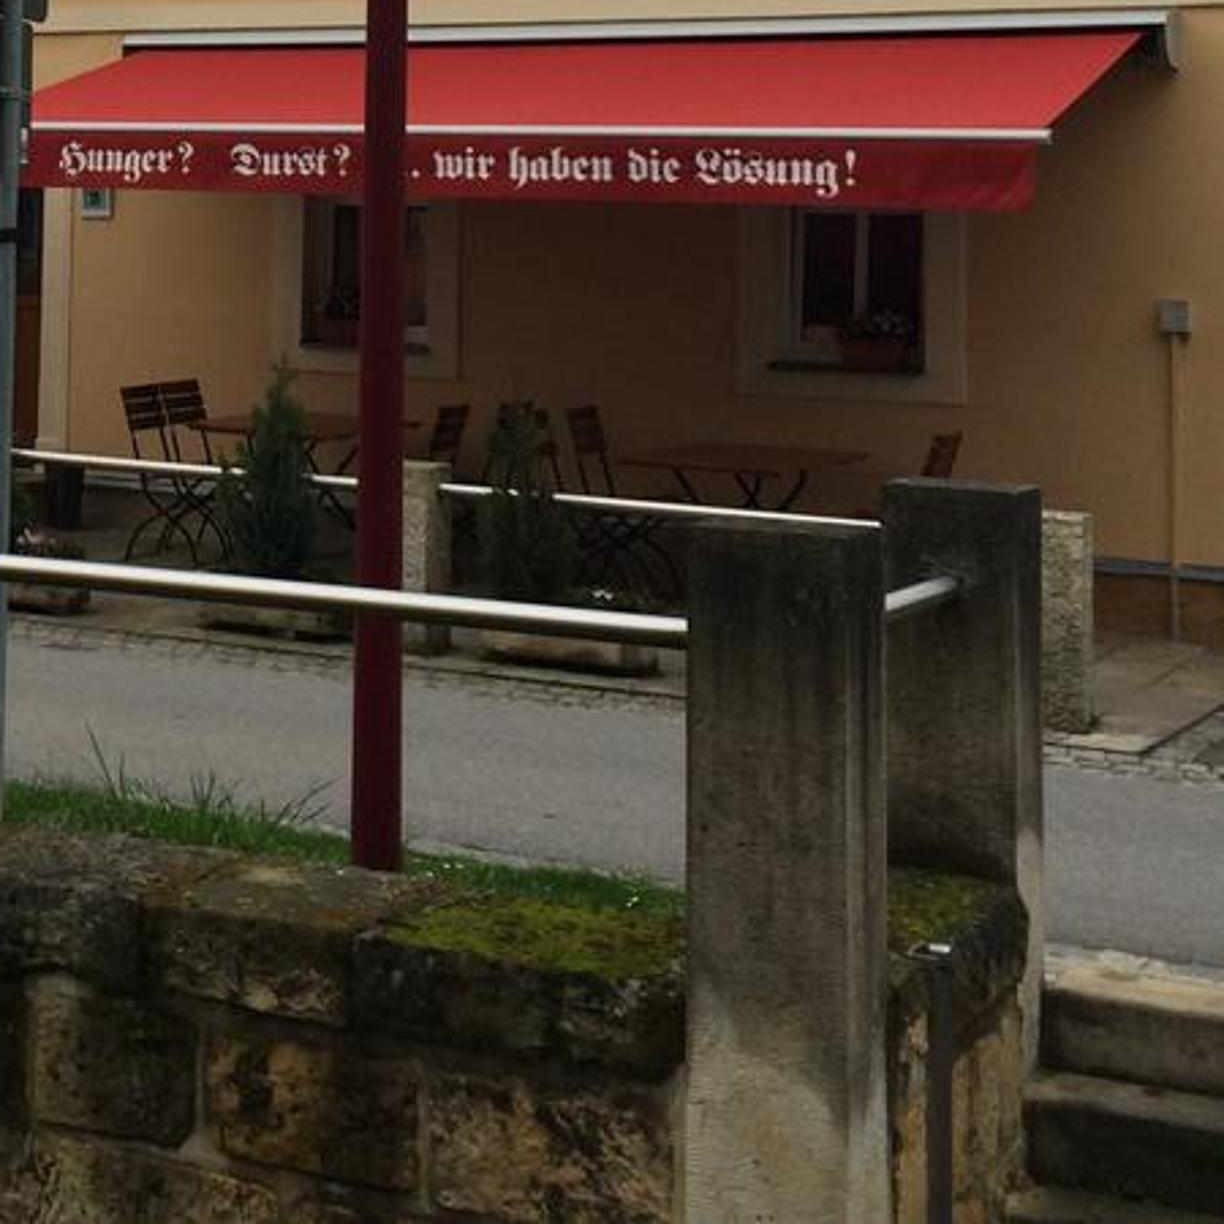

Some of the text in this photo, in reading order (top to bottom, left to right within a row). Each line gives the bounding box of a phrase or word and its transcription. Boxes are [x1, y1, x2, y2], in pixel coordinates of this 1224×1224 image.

[59, 141, 857, 198] Hunger? Durst? wir haben die Lösung!
